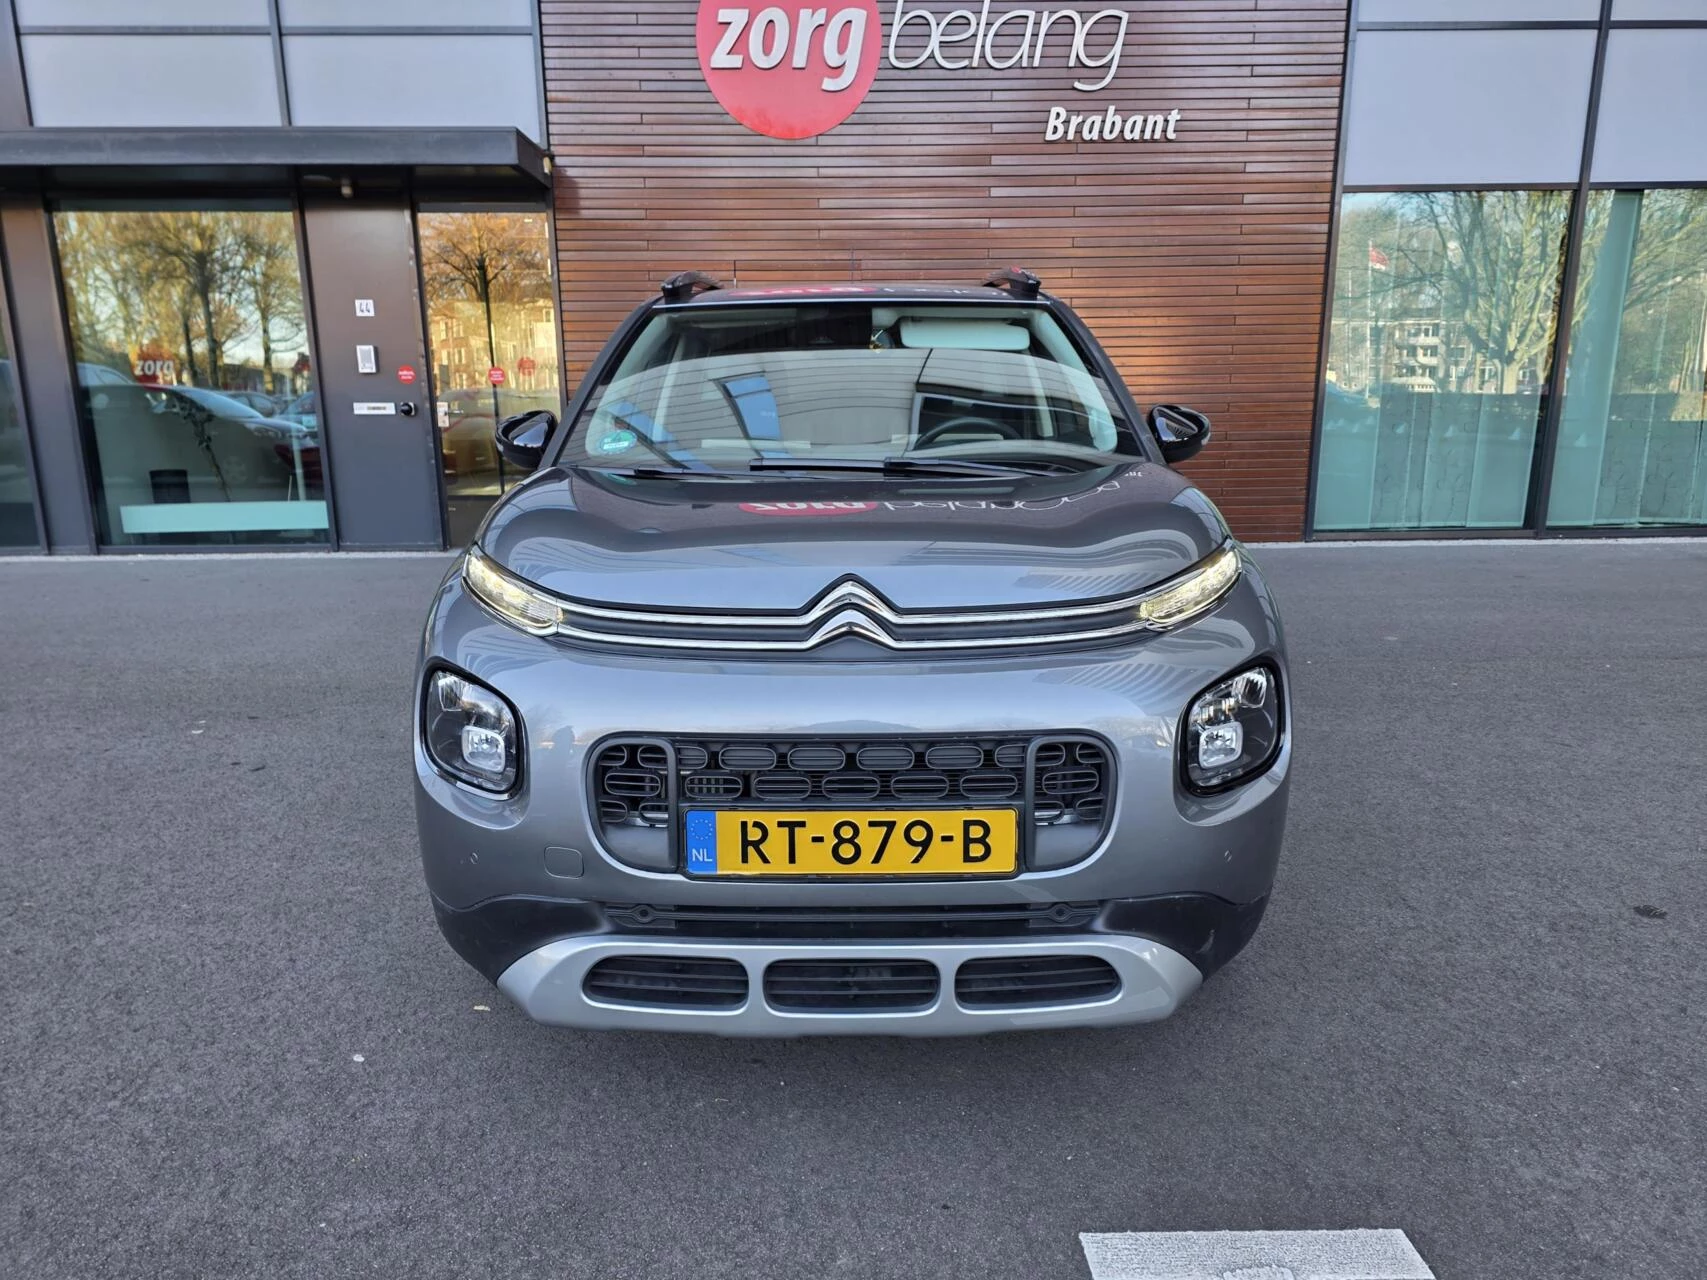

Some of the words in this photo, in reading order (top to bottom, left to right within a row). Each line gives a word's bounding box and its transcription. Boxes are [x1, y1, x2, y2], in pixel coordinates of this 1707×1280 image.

[710, 6, 868, 92] zorg
[888, 0, 1129, 91] belang
[1045, 106, 1180, 142] Brabant
[359, 302, 371, 313] 44
[691, 848, 713, 862] NL
[740, 819, 992, 865] RT-879-B
